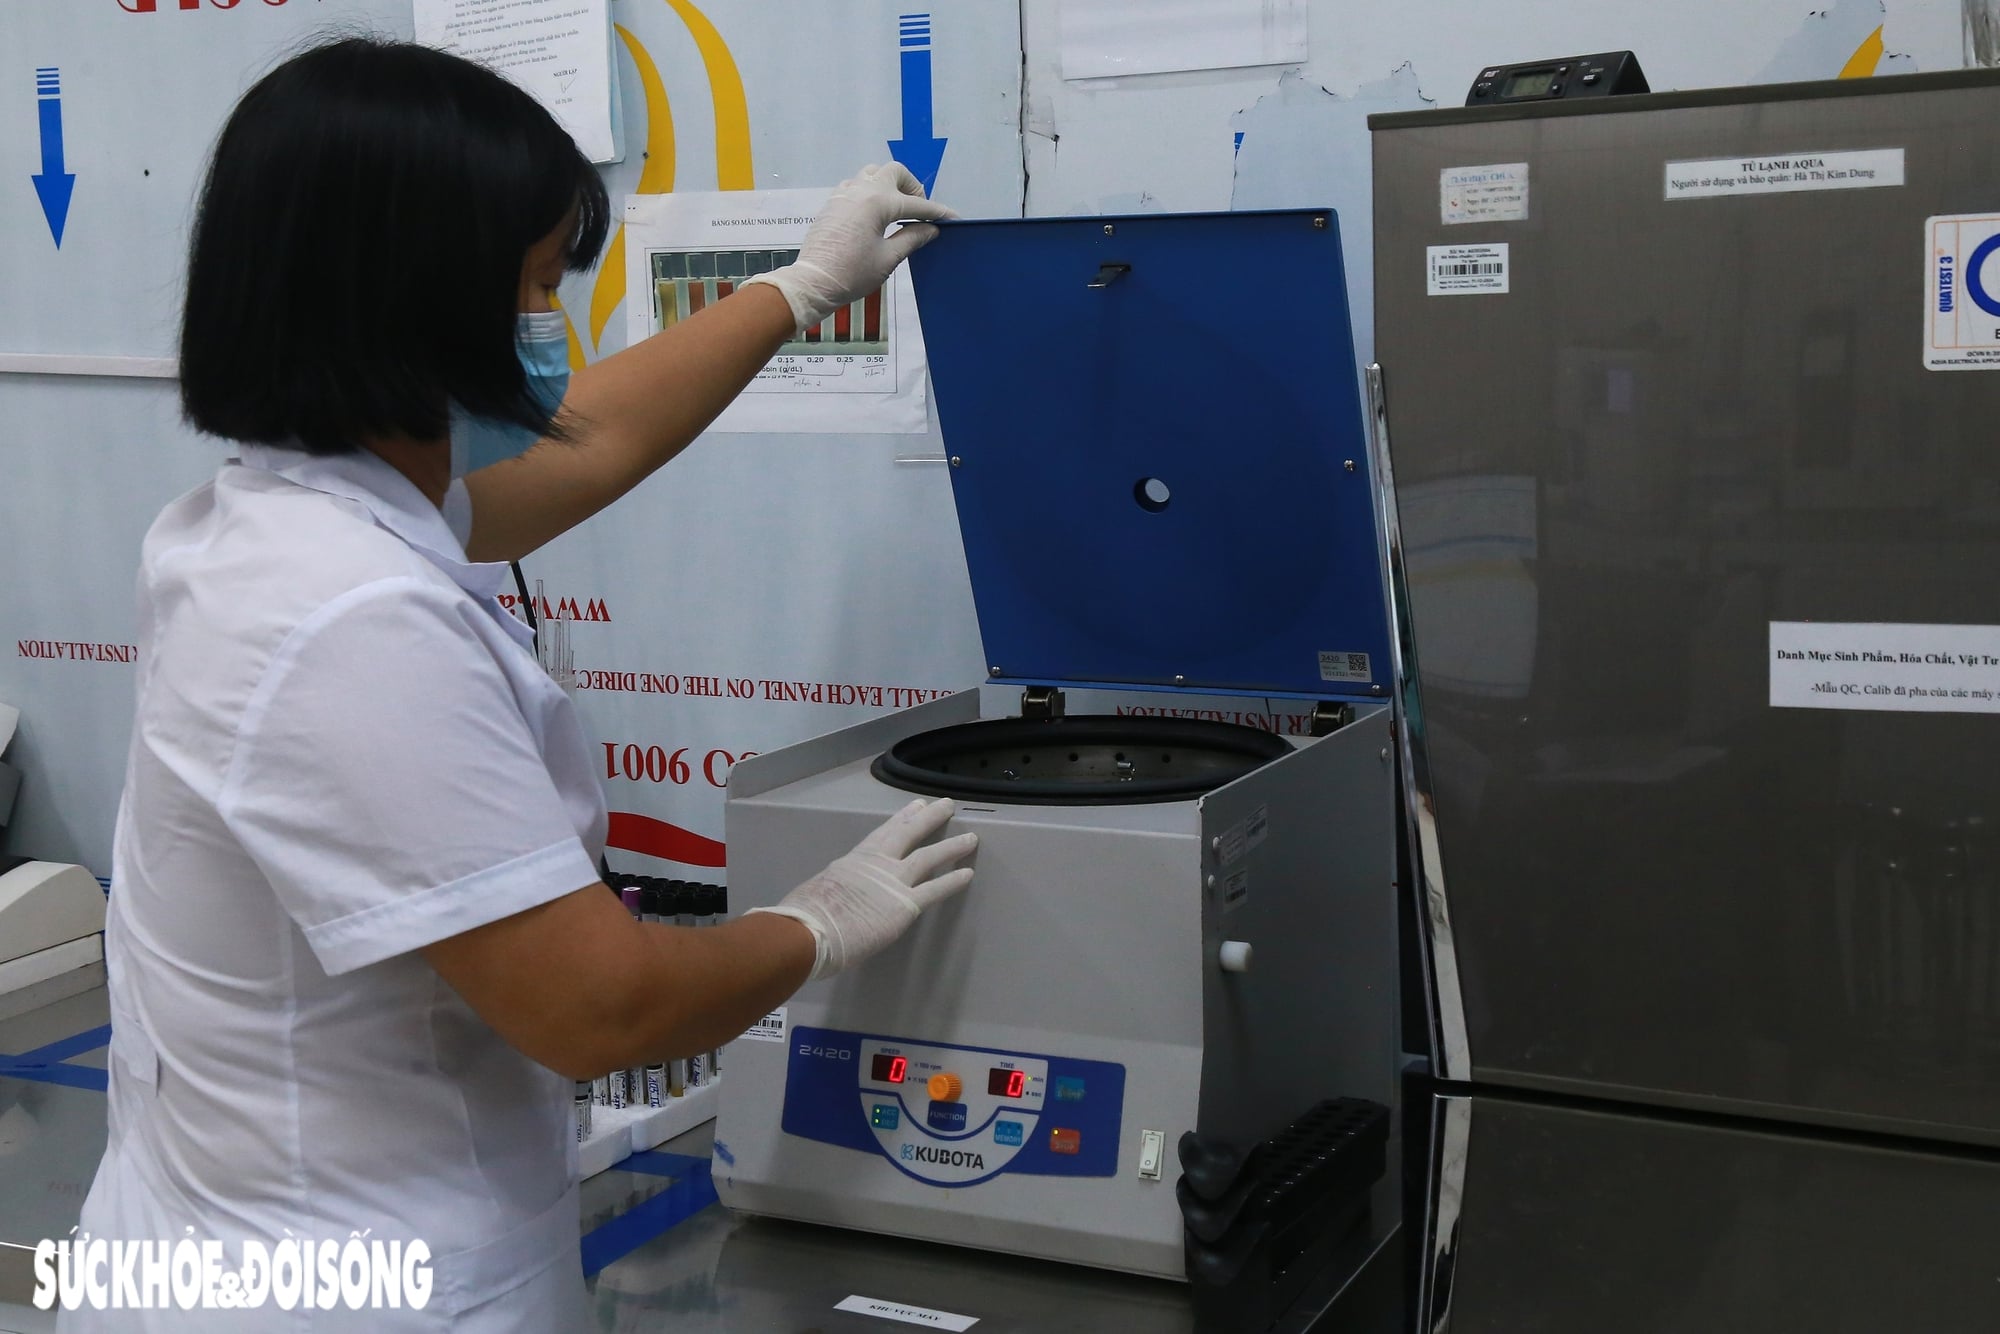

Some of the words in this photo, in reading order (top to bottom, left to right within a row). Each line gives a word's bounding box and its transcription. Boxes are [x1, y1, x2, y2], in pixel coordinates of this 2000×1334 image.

[1741, 160, 1757, 173] TỦ
[1759, 160, 1790, 173] LẠNH
[1792, 158, 1825, 170] AQUA
[1671, 176, 1699, 191] Người
[1713, 175, 1735, 190] dụng
[1737, 173, 1748, 185] và
[1794, 171, 1808, 182] Hà
[1810, 169, 1825, 182] Thị
[1827, 169, 1847, 180] Kim
[1849, 168, 1876, 180] Dung
[1940, 256, 1953, 264] 3
[1939, 267, 1953, 313] QUATEST
[18, 639, 131, 663] INSTALLATION
[1777, 649, 1805, 661] Danh
[1808, 650, 1832, 664] Mục
[1834, 650, 1859, 662] Sinh
[1899, 652, 1922, 664] Hóa
[1925, 651, 1956, 665] Chất,
[1958, 653, 1978, 667] Vật
[639, 673, 680, 695] ONE
[683, 675, 723, 697] THE
[726, 677, 755, 699] ON
[758, 680, 823, 703] PANEL
[827, 683, 884, 707] EACH
[1840, 684, 1861, 695] QC,
[1863, 684, 1891, 695] Calib
[1894, 685, 1907, 696] đã
[1909, 686, 1928, 699] pha
[1951, 686, 1969, 699] các
[1972, 689, 1993, 701] máy
[887, 687, 956, 708] TALL
[601, 741, 691, 785] 9001
[799, 1044, 851, 1061] 2420
[880, 1047, 901, 1055] SPEED
[889, 1055, 908, 1083] 0
[930, 1063, 942, 1071] rpm
[1000, 1061, 1015, 1069] TIME
[1006, 1070, 1025, 1098] 0
[929, 1111, 966, 1122] FUNCTION
[995, 1133, 1022, 1145] MEMORY
[915, 1145, 985, 1170] KUBOTA
